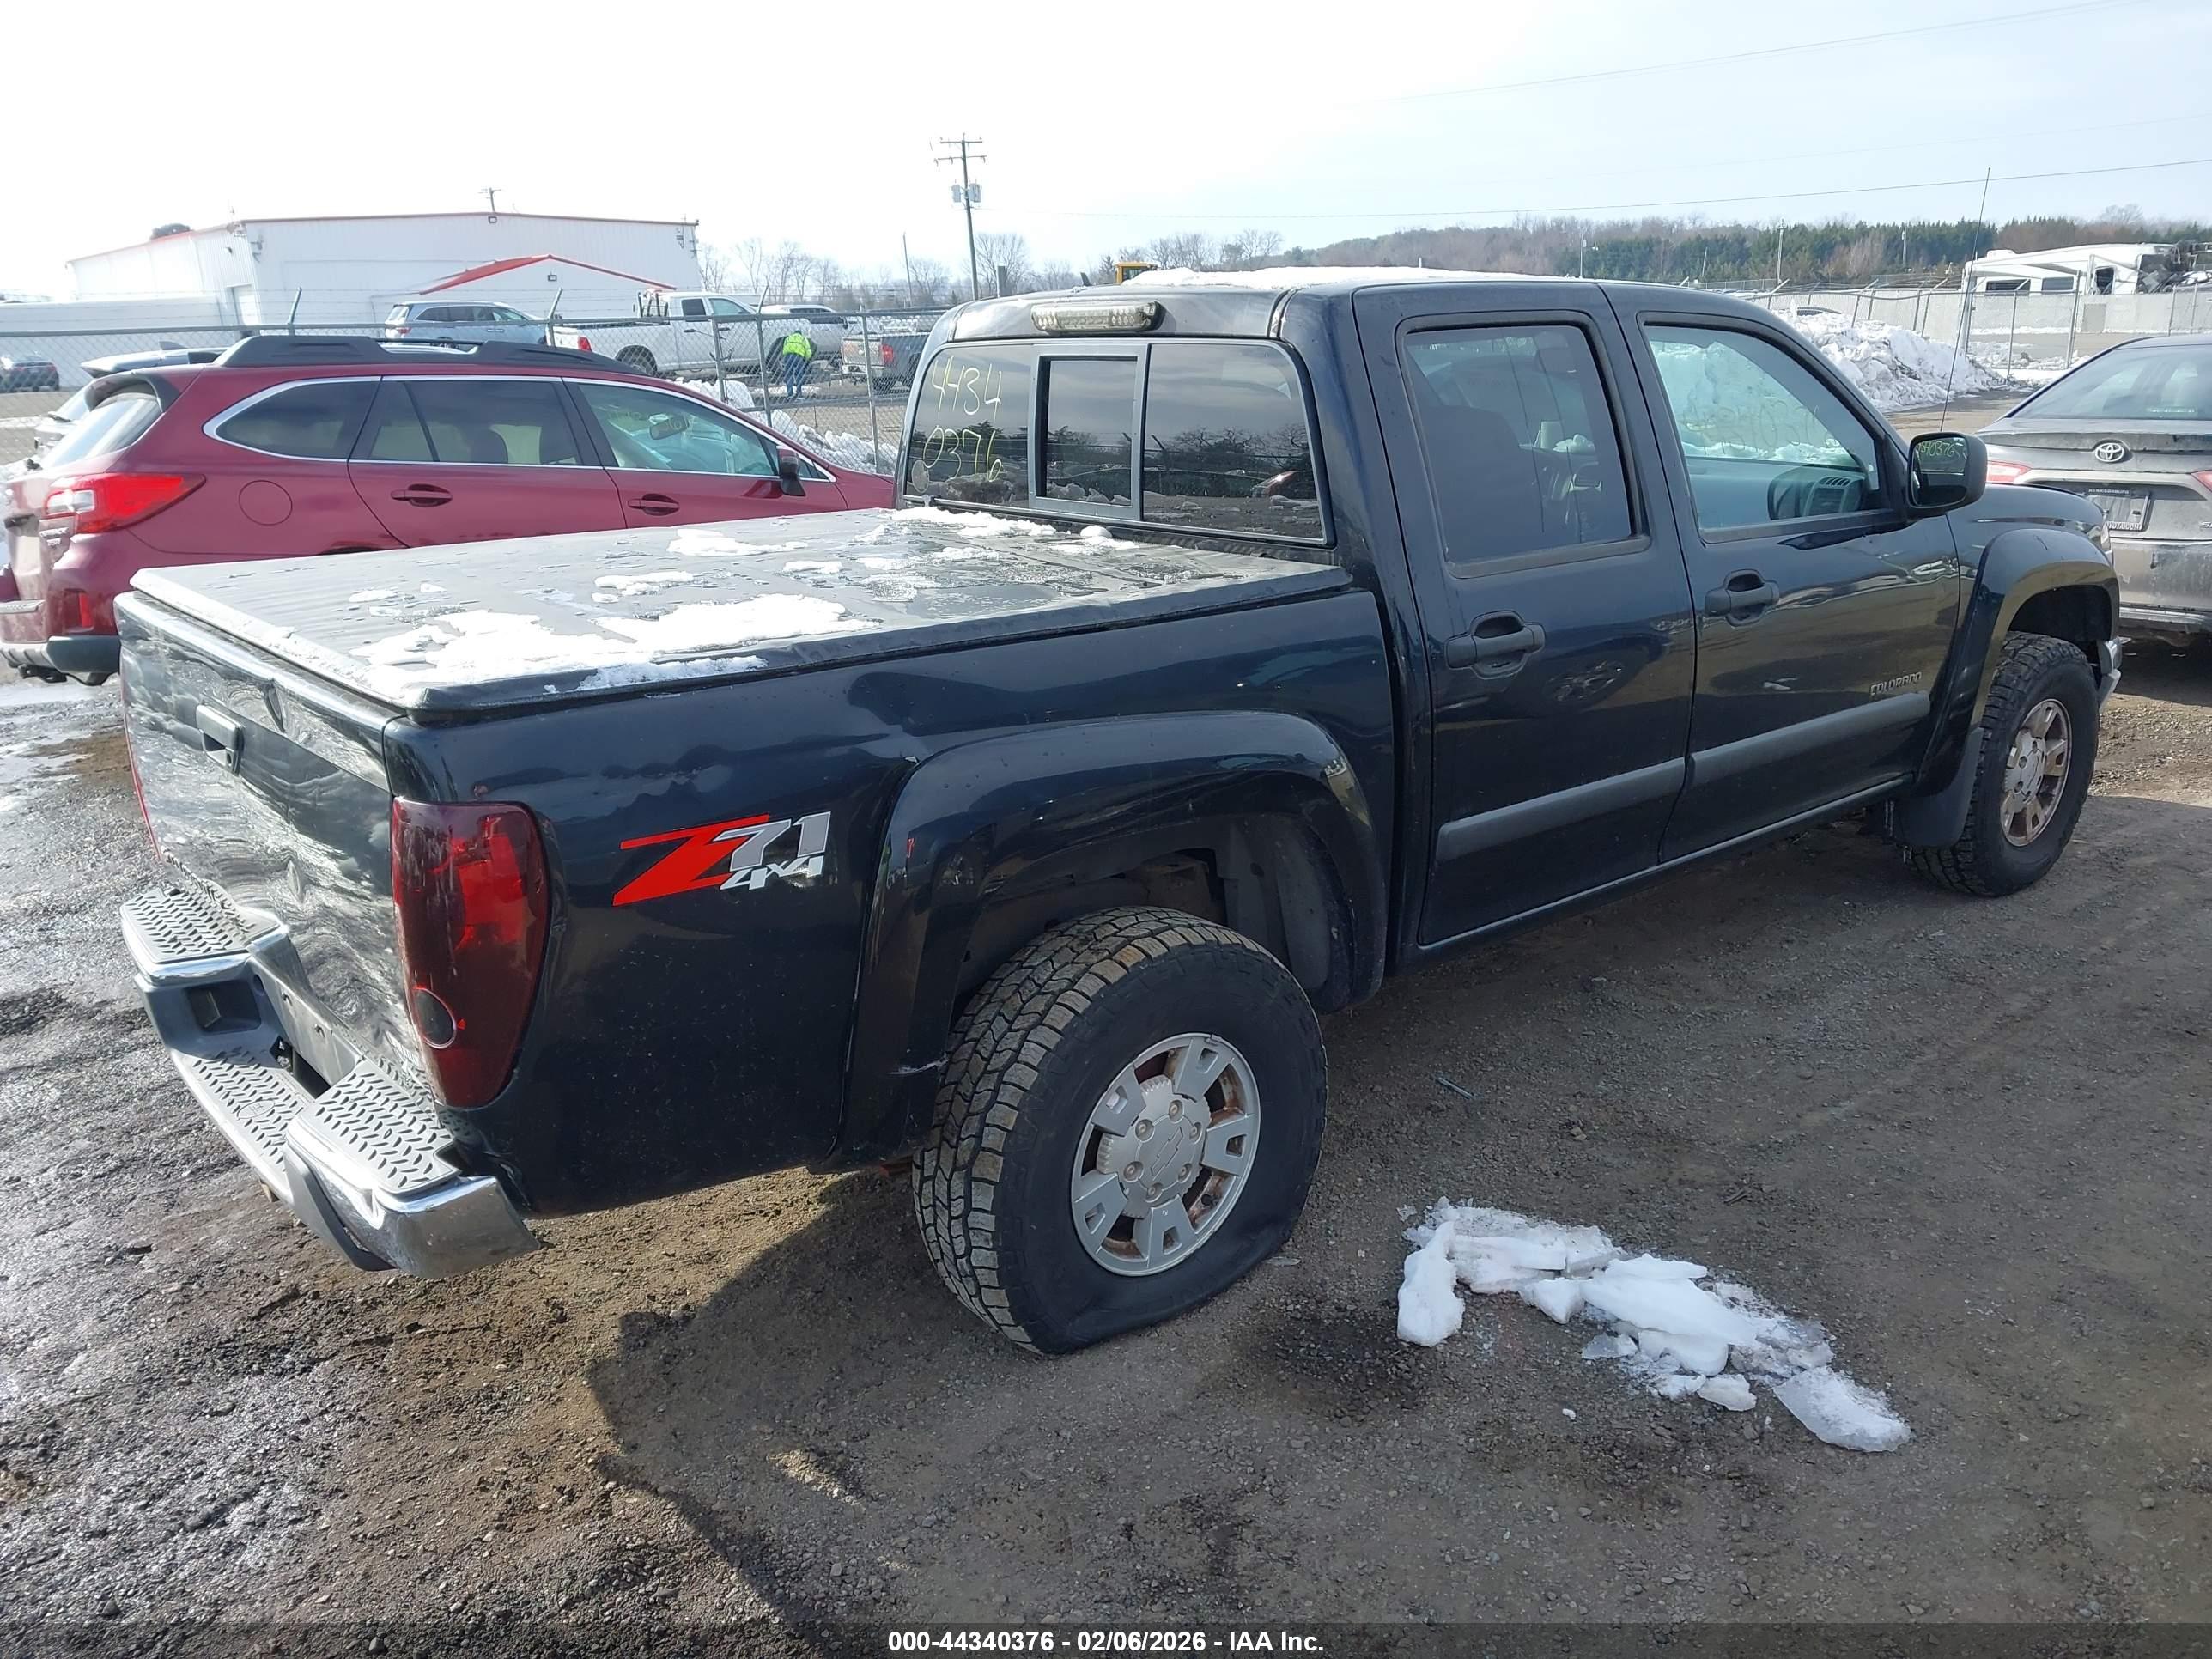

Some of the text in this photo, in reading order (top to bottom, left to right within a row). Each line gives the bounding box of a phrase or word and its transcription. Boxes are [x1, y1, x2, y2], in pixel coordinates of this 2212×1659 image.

[932, 355, 1002, 421] 4434
[923, 425, 1003, 483] 0376
[1870, 672, 1923, 696] COLORADO
[612, 811, 831, 908] Z71
